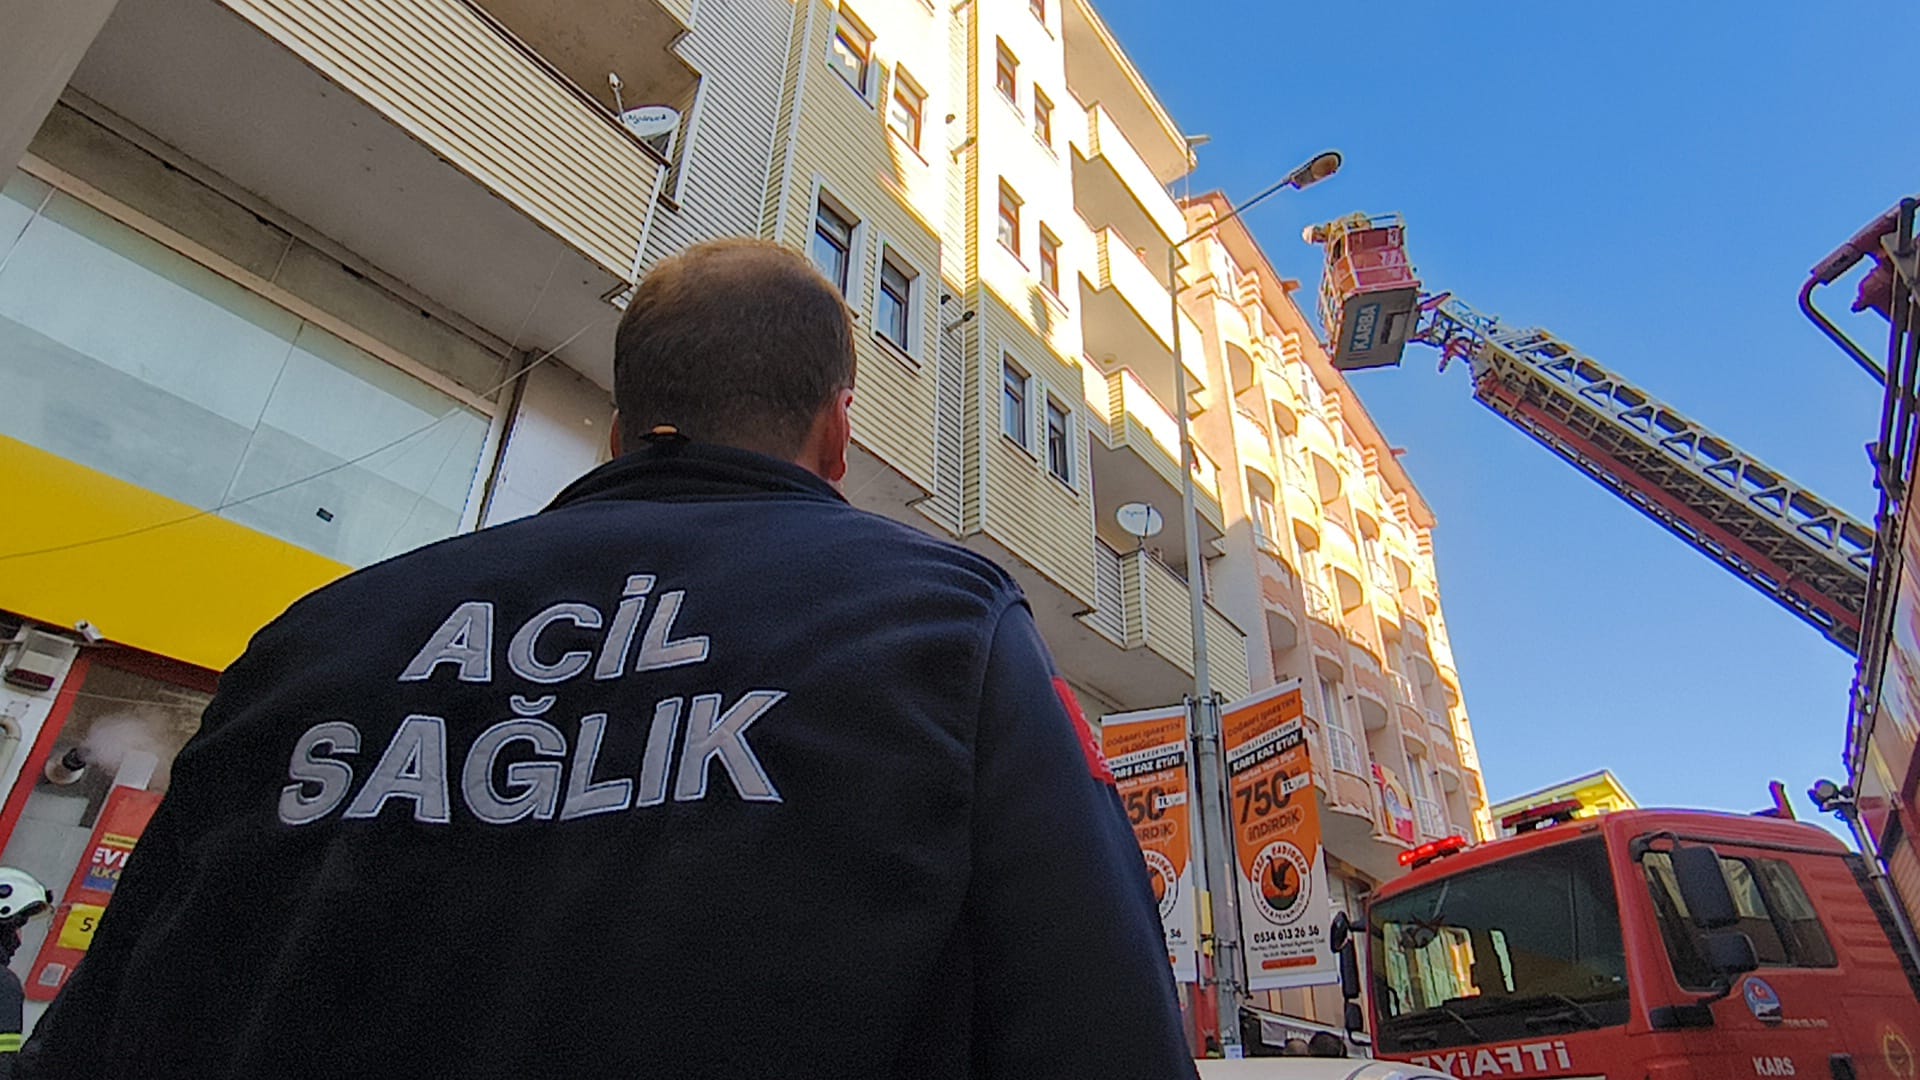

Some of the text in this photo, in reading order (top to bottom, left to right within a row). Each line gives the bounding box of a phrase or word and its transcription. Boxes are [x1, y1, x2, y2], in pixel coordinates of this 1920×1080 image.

[398, 573, 710, 684] ACİL
[278, 690, 788, 826] SAĞLIK
[1114, 766, 1133, 779] ARS
[1134, 760, 1155, 775] KAZ
[1232, 753, 1256, 773] KARS
[1256, 743, 1276, 761] KAZ
[1123, 786, 1166, 825] 50
[1235, 771, 1291, 825] 750
[1752, 1055, 1797, 1078] KARS
